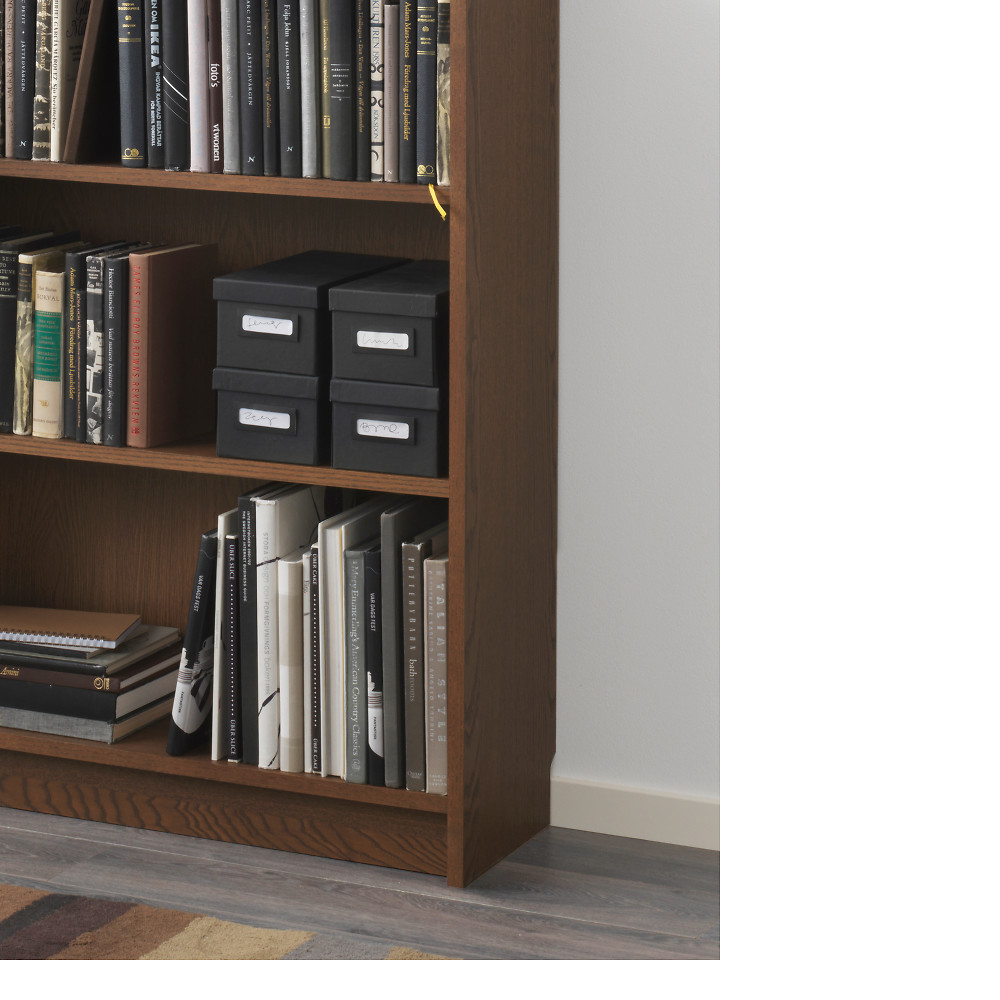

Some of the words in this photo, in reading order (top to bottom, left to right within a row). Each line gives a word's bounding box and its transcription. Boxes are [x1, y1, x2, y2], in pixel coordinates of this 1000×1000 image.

[151, 10, 158, 23] OM
[150, 24, 160, 67] IKEA
[210, 63, 220, 88] foto's
[402, 64, 411, 92] Föredrag
[403, 93, 411, 108] med
[402, 108, 411, 141] Ljusbilder
[212, 123, 220, 161] vtwonen
[69, 267, 77, 287] Adam
[133, 265, 141, 295] JAMES
[133, 299, 141, 335] ELLROY
[132, 339, 140, 378] BROWNS
[131, 382, 140, 424] REKVIEM
[350, 565, 359, 588] Mary
[350, 589, 360, 643] Emmerling's
[352, 643, 360, 685] American
[408, 659, 418, 702] bathrooms
[351, 687, 360, 722] Country
[352, 724, 360, 756] Classics
